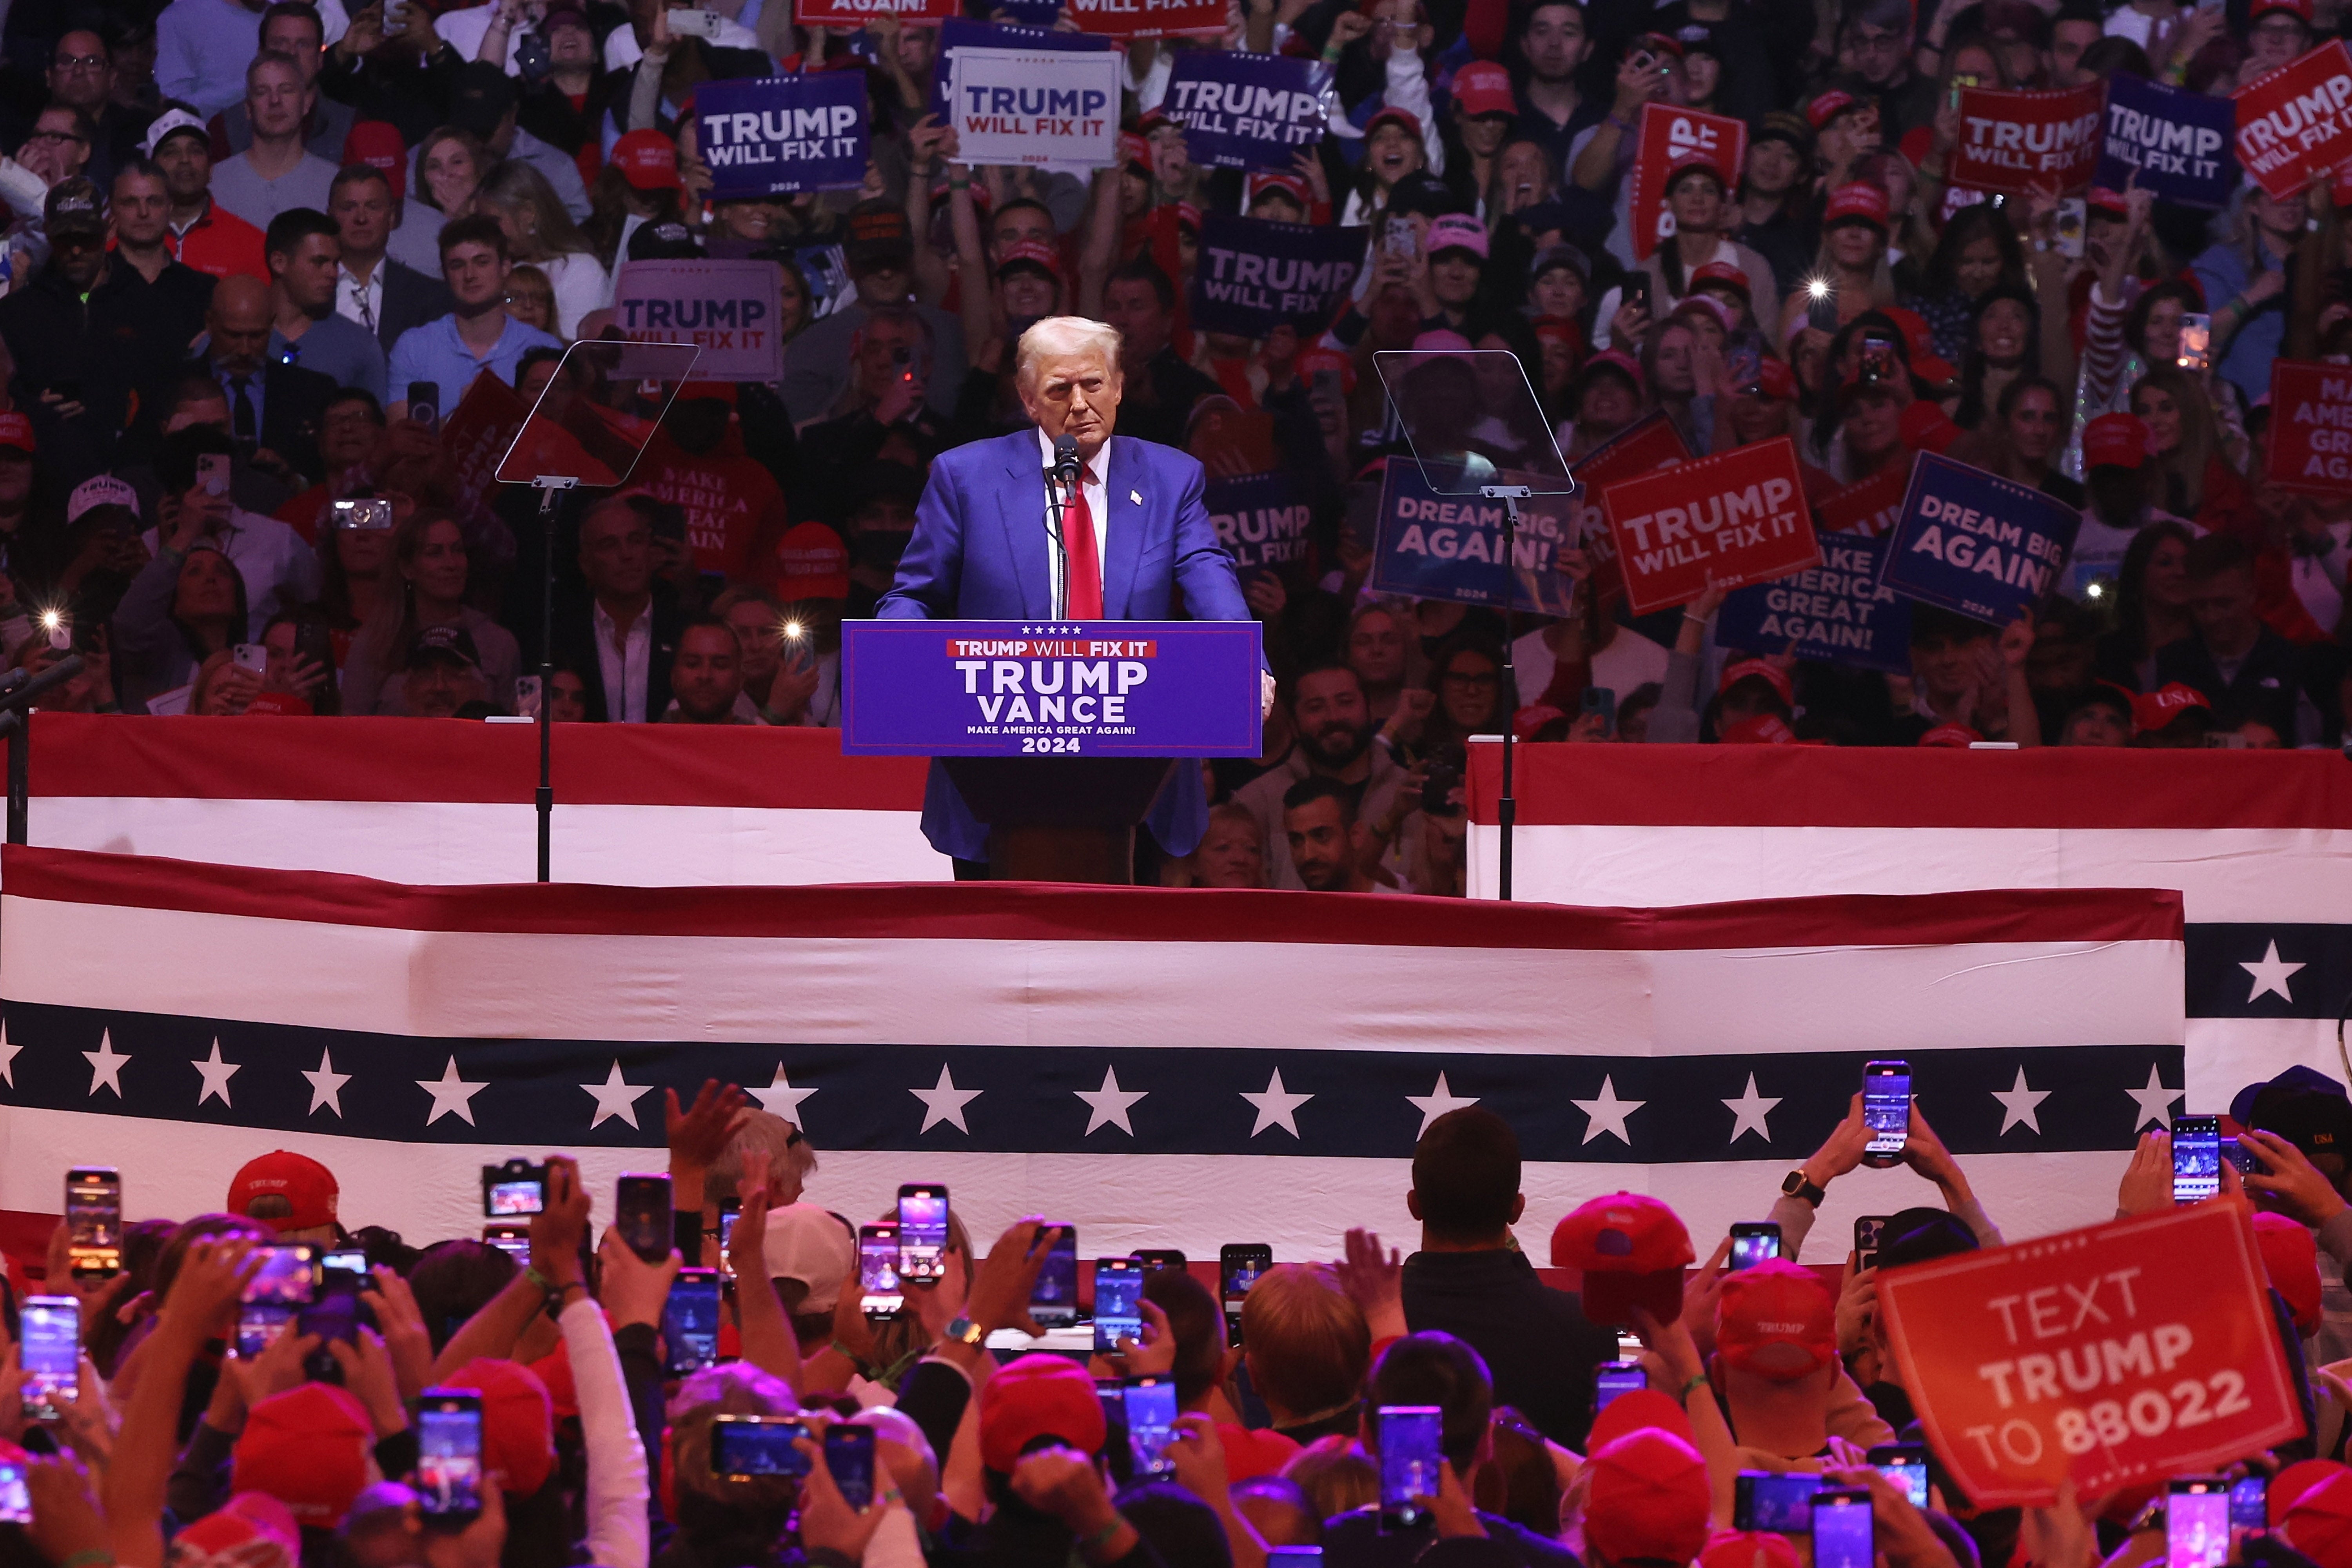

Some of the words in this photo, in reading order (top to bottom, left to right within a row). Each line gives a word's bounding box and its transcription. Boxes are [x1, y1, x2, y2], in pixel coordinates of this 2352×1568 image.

[966, 86, 1106, 116] TRUMP
[1174, 81, 1319, 124] TRUMP
[2238, 74, 2352, 157] TRUMP
[703, 105, 858, 146] TRUMP
[967, 116, 1027, 134] WILL
[1036, 118, 1073, 136] FIX
[1083, 120, 1105, 136] IT
[1235, 119, 1278, 143] FIX
[1285, 124, 1313, 144] IT
[1965, 112, 2099, 153] TRUMP
[2109, 103, 2223, 157] TRUMP
[706, 144, 776, 167] WILL
[782, 140, 827, 163] FIX
[833, 137, 858, 158] IT
[1965, 143, 2032, 171] WILL
[2038, 150, 2074, 172] FIX
[2080, 141, 2094, 161] IT
[2105, 138, 2143, 167] WILL
[2144, 153, 2188, 178] FIX
[2193, 160, 2221, 179] IT
[2250, 147, 2299, 176] WILL
[2301, 117, 2343, 150] FIX
[770, 181, 800, 192] 2024
[1207, 247, 1356, 292] TRUMP
[1204, 280, 1273, 312] WILL
[1281, 294, 1321, 313] FIX
[622, 299, 766, 329] TRUMP
[693, 331, 735, 350] FIX
[741, 330, 764, 349] IT
[1210, 505, 1310, 545] RUMP
[1397, 497, 1501, 529] DREAM
[1623, 476, 1793, 552] TRUMP
[1920, 495, 2022, 547] DREAM
[1261, 542, 1292, 564] FIX
[1396, 524, 1551, 572] AGAIN!
[1632, 545, 1711, 575] WILL
[1717, 525, 1766, 554] FIX
[1772, 512, 1797, 538] IT
[1911, 525, 2053, 599] AGAIN!
[1455, 588, 1488, 599] 2024
[1766, 589, 1875, 624] GREAT
[1961, 599, 1995, 617] 2024
[955, 641, 1028, 657] TRUMP
[1033, 641, 1083, 657] WILL
[1089, 641, 1123, 657] FIX
[1128, 641, 1148, 657] IT
[1759, 614, 1874, 651] AGAIN!
[955, 661, 1149, 694] TRUMP
[977, 696, 1125, 722] VANCE
[2156, 691, 2198, 707] USA
[967, 726, 998, 734] MAKE
[1002, 726, 1053, 734] AMERICA
[1057, 726, 1093, 734] GREAT
[1096, 726, 1136, 734] AGAIN!
[1022, 738, 1080, 753] 2024
[2314, 1134, 2334, 1145] USA
[1987, 1266, 2141, 1346] TEXT
[1757, 1321, 1805, 1334] TRUMP
[1979, 1323, 2193, 1409] TRUMP
[1965, 1418, 2042, 1471] TO
[2054, 1368, 2252, 1455] 88022
